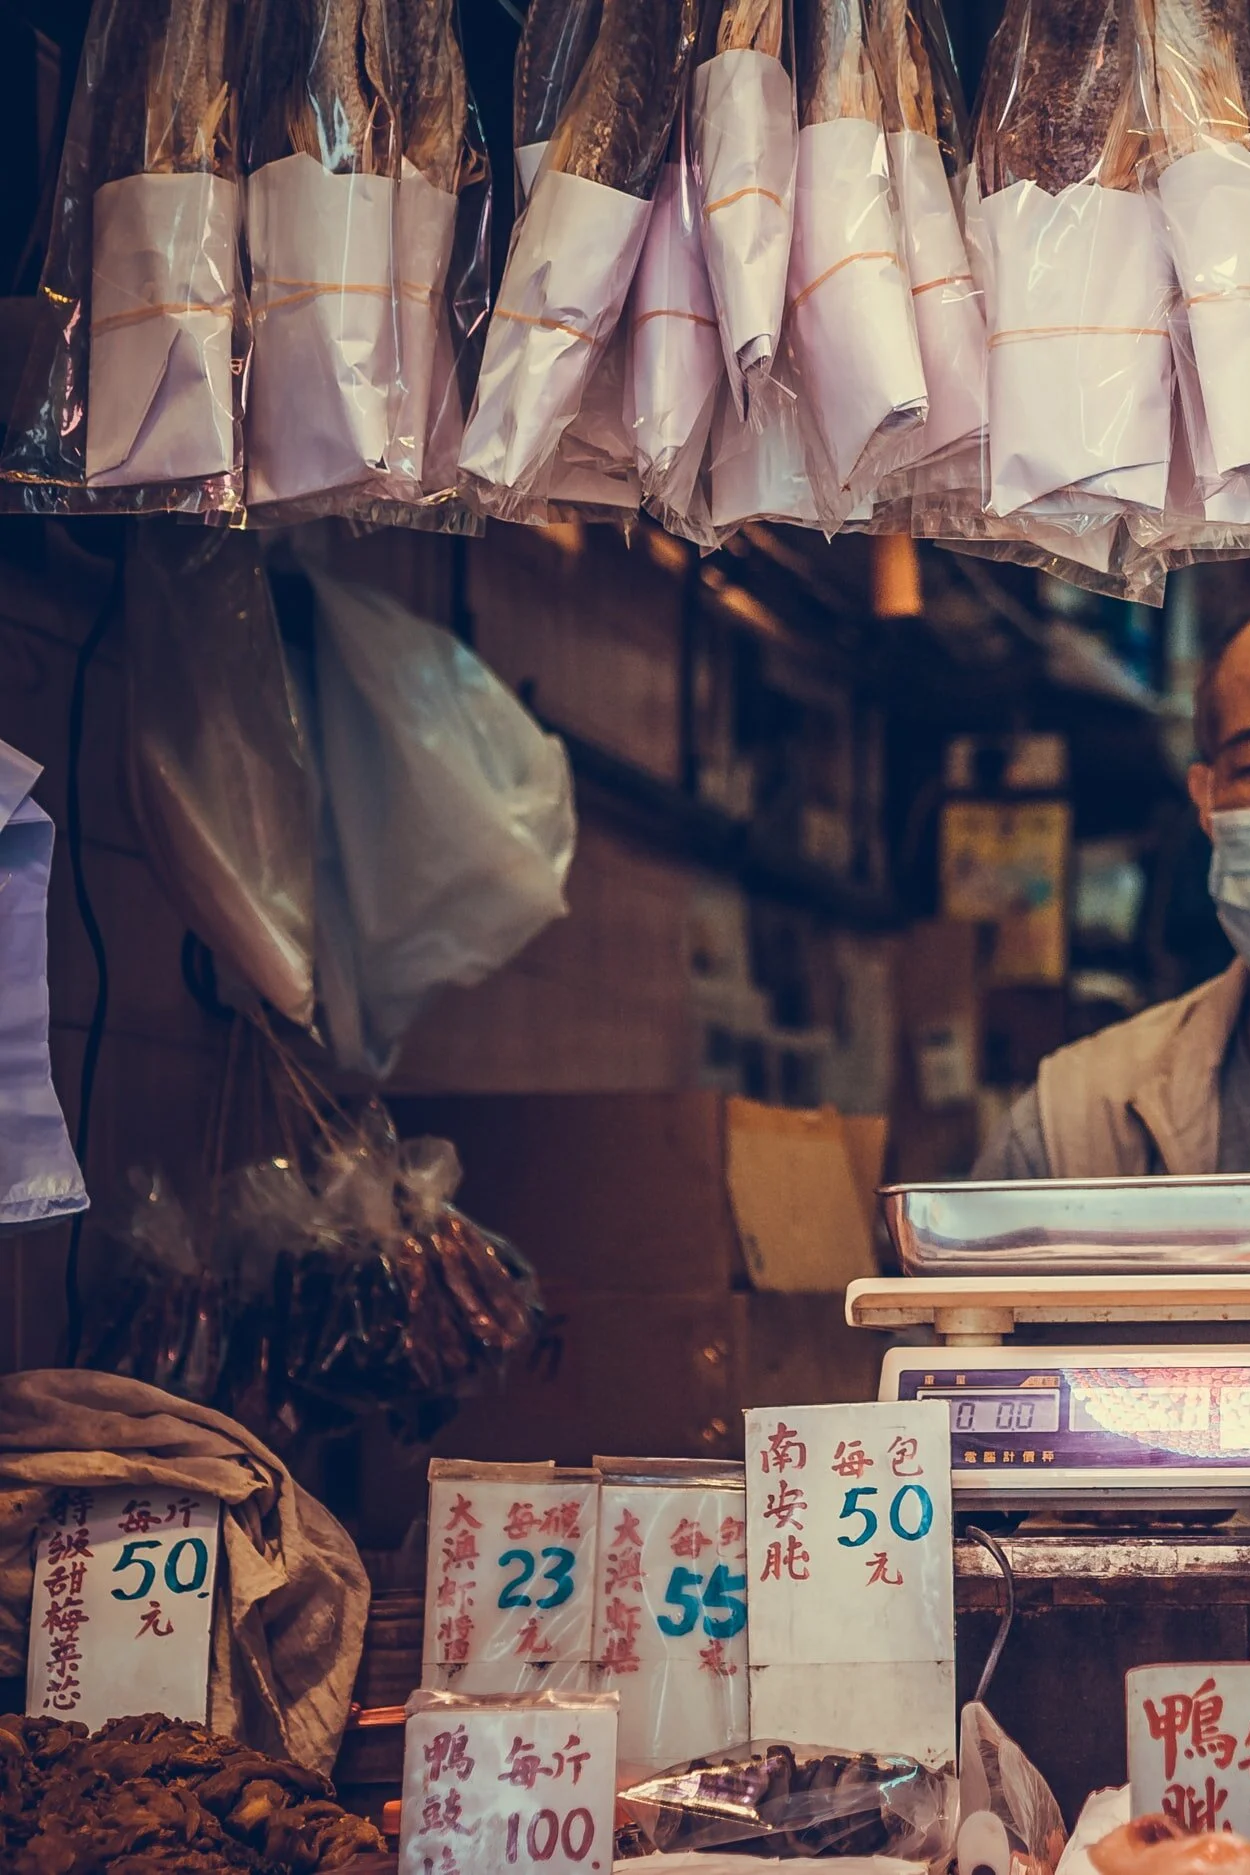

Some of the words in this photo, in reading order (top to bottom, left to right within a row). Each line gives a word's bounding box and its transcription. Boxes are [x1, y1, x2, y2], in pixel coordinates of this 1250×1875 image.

[831, 1436, 923, 1479] 每包
[118, 1498, 199, 1533] 每斤
[760, 1422, 809, 1582] 南安肫
[837, 1484, 933, 1547] 50
[497, 1547, 575, 1609] 23
[865, 1552, 903, 1586] 元
[134, 1600, 174, 1639] 元
[656, 1564, 747, 1638] 55
[514, 1617, 553, 1655] 元
[498, 1735, 591, 1789] 每斤
